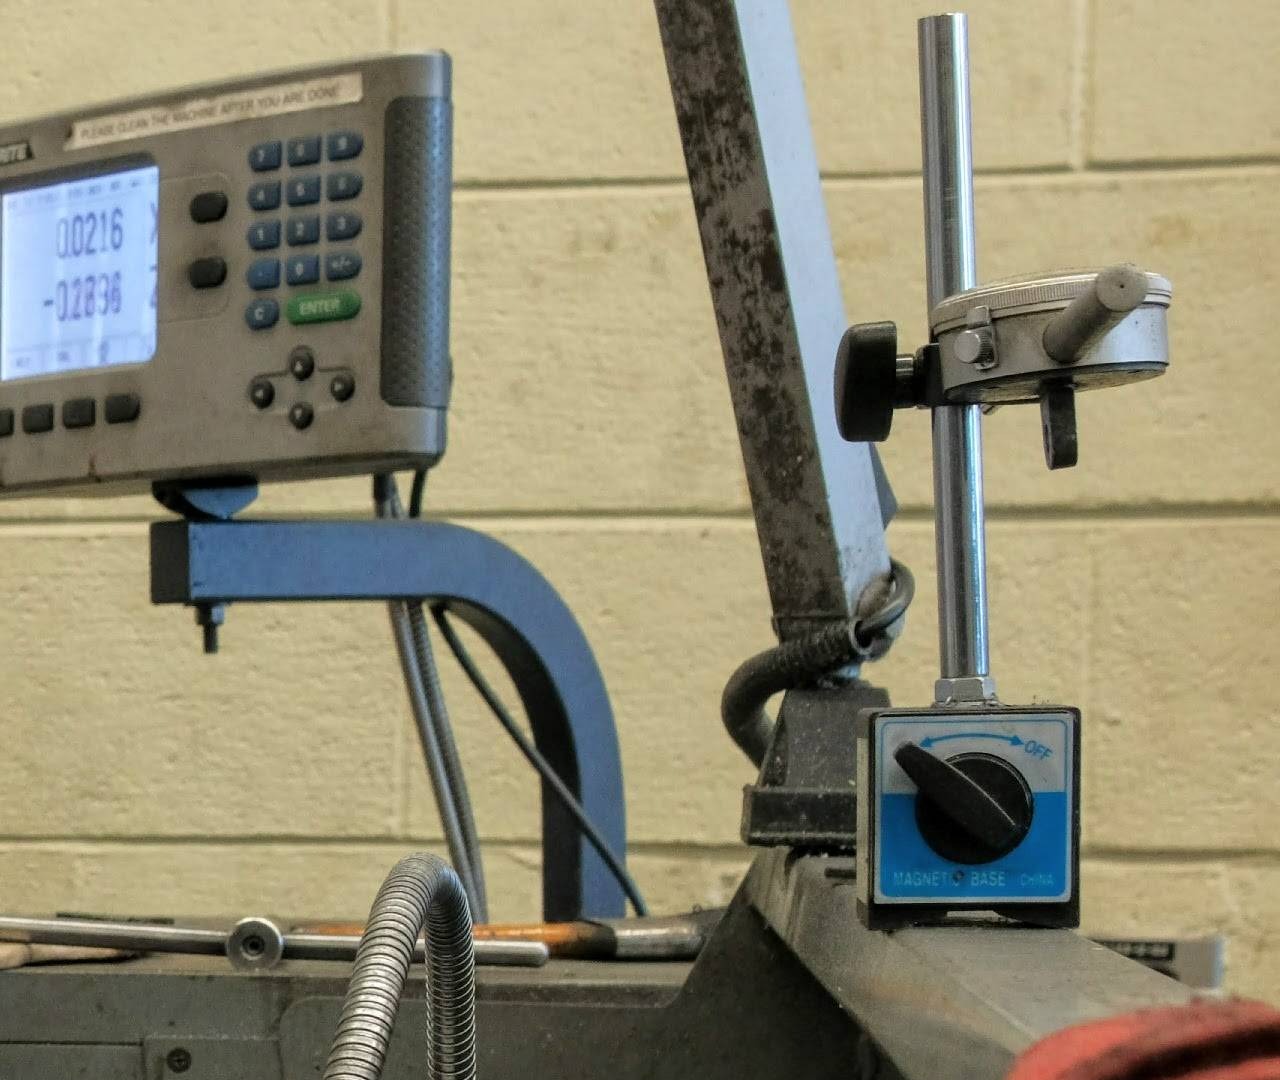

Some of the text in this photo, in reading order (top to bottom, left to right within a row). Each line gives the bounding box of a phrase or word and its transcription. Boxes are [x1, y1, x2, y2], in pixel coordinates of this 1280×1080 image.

[117, 119, 148, 133] CLEAN
[256, 96, 281, 109] YOU
[299, 298, 340, 317] ENTER
[1024, 740, 1053, 761] OFF
[970, 870, 1007, 888] BASE
[1020, 873, 1055, 887] CHINA
